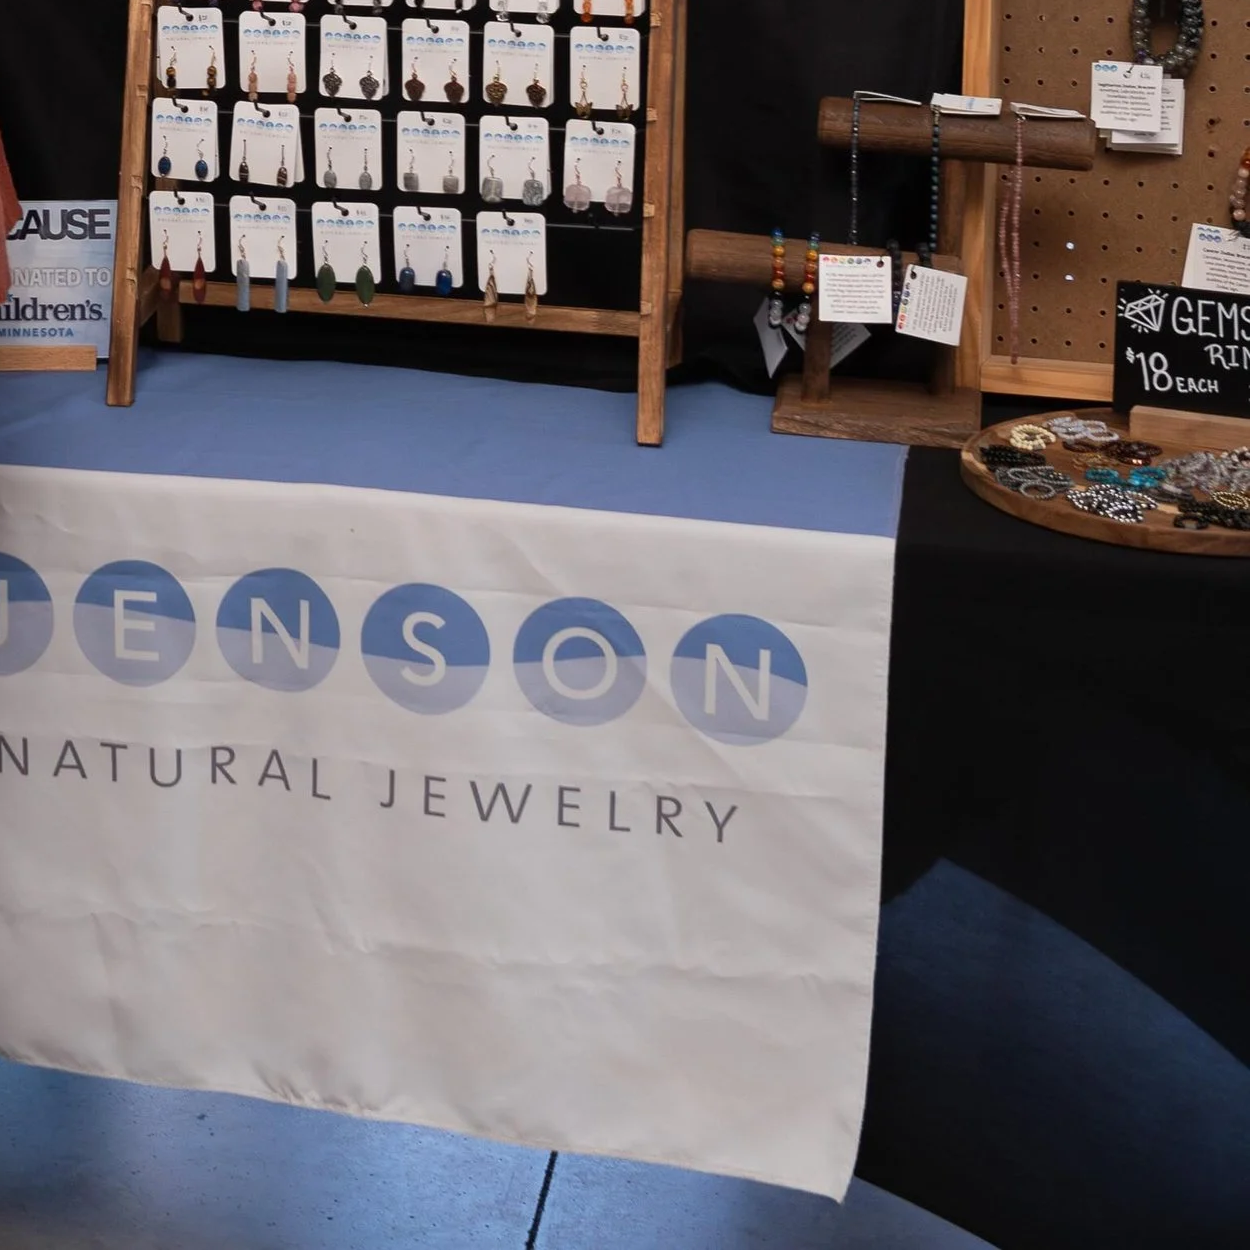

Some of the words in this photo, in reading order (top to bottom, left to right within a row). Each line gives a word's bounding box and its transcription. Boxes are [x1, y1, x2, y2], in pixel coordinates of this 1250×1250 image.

[11, 267, 82, 287] NATED
[84, 267, 112, 286] TO
[1125, 346, 1173, 391] $18
[1175, 376, 1219, 393] EACH
[377, 767, 740, 845] JEWELRY
